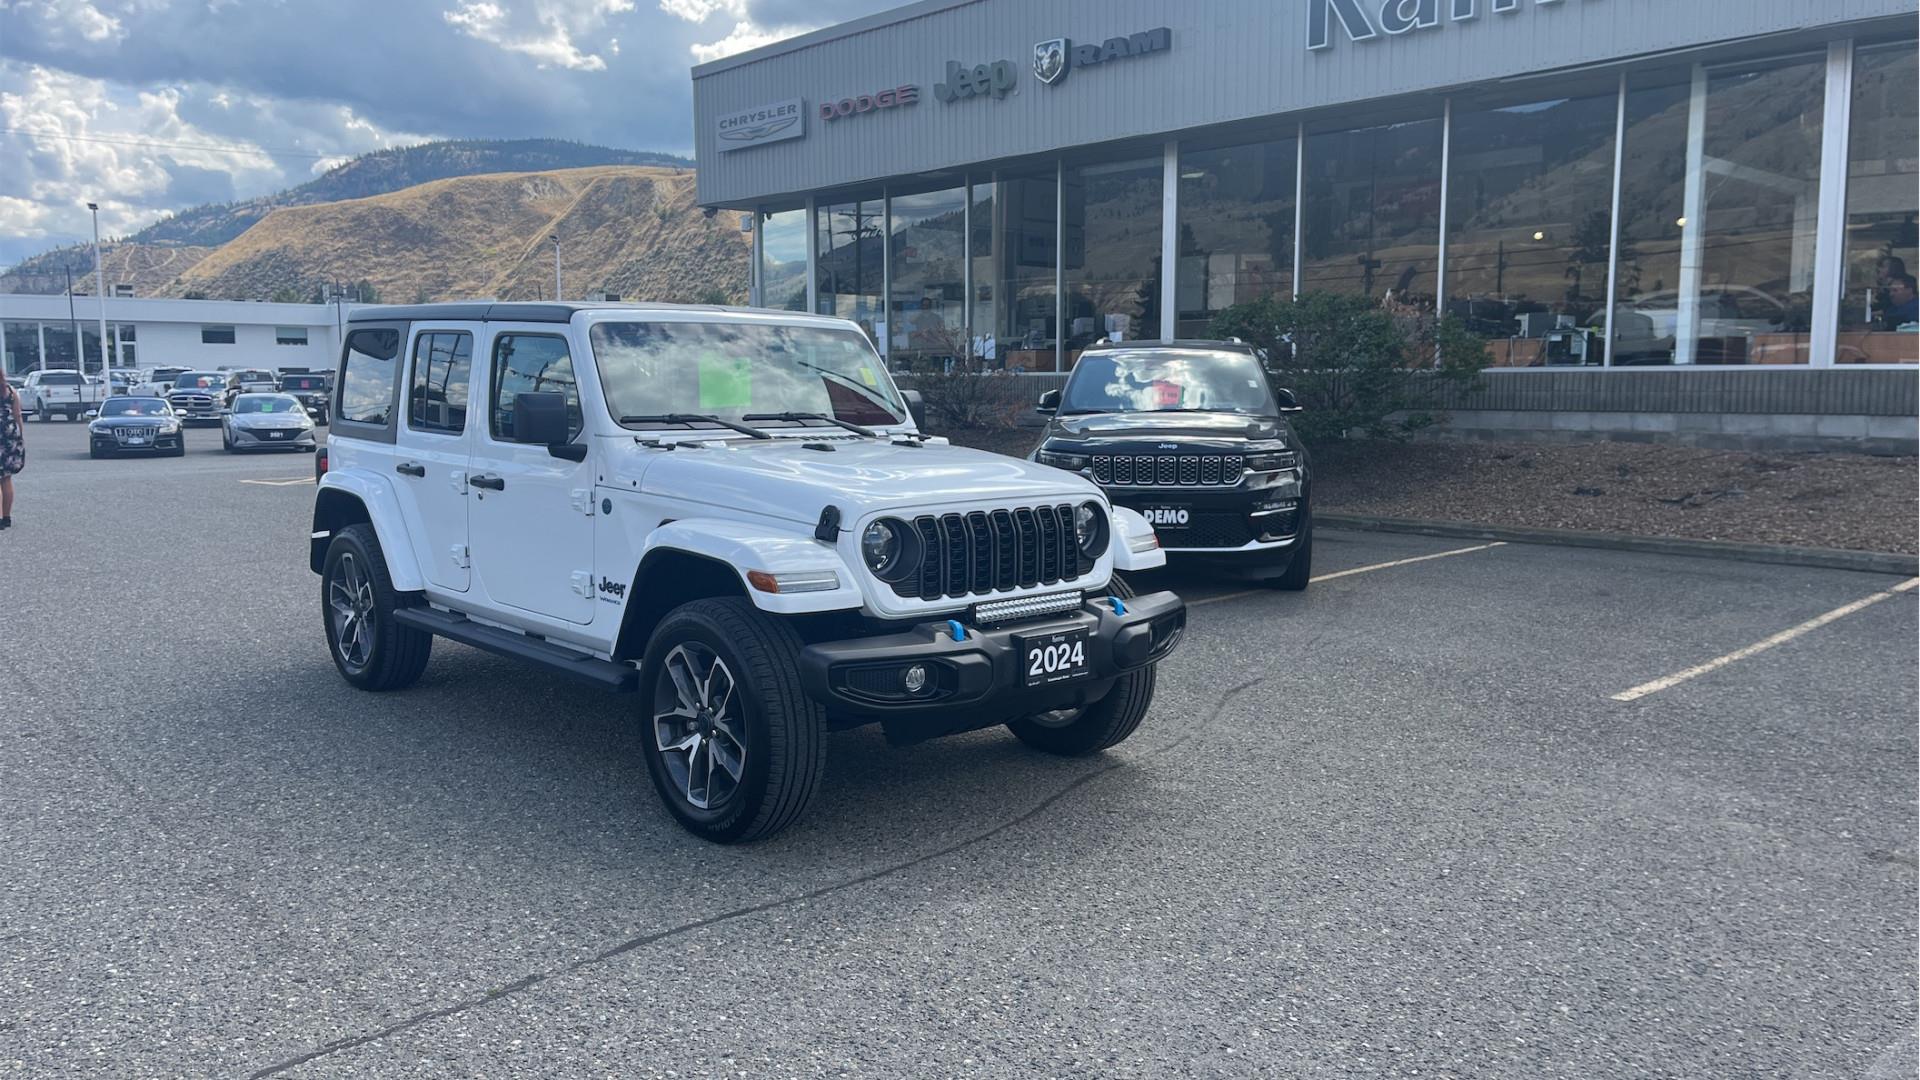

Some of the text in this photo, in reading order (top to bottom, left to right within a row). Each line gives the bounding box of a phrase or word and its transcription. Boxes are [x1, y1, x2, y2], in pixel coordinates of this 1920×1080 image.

[1071, 27, 1171, 68] RAM
[934, 60, 1016, 102] Jeep
[720, 104, 797, 129] CHRYSLER
[820, 85, 920, 120] DODGE
[1143, 509, 1189, 524] DEMO
[599, 576, 626, 599] Jeep
[1029, 640, 1084, 676] 2024
